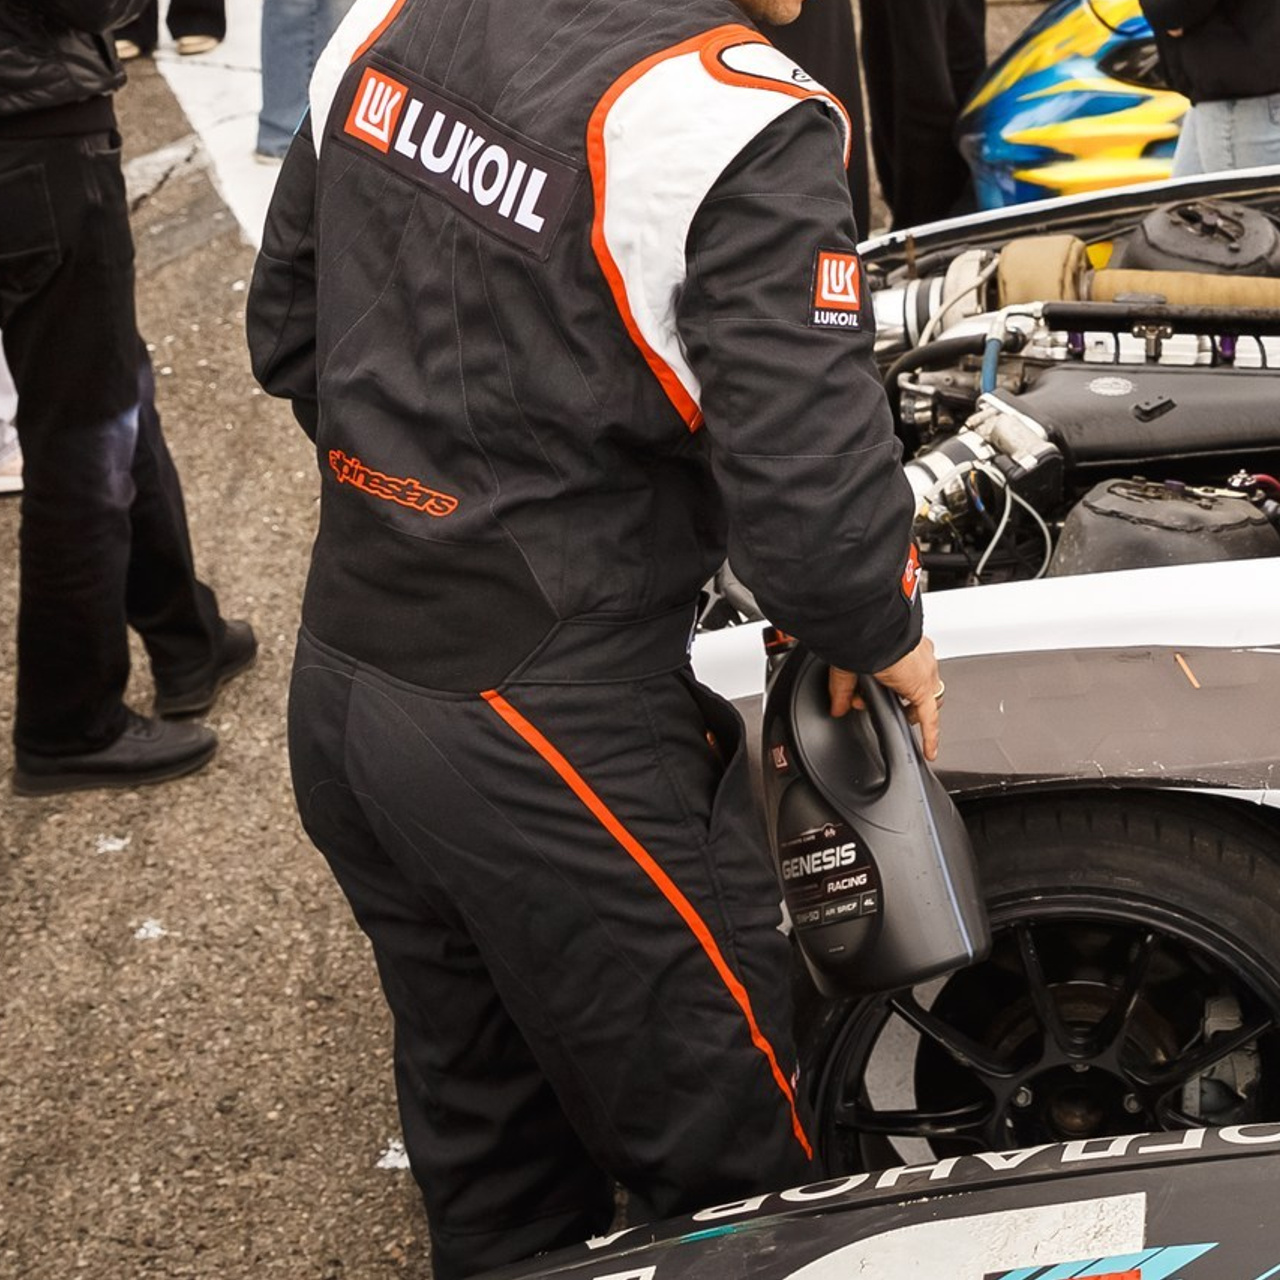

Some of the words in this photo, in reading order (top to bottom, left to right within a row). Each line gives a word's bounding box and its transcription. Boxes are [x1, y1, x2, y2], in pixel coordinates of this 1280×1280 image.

[394, 98, 548, 234] LUKOIL
[814, 310, 859, 326] LUKOIL
[781, 842, 857, 881] GENESIS
[827, 873, 868, 894] RACING
